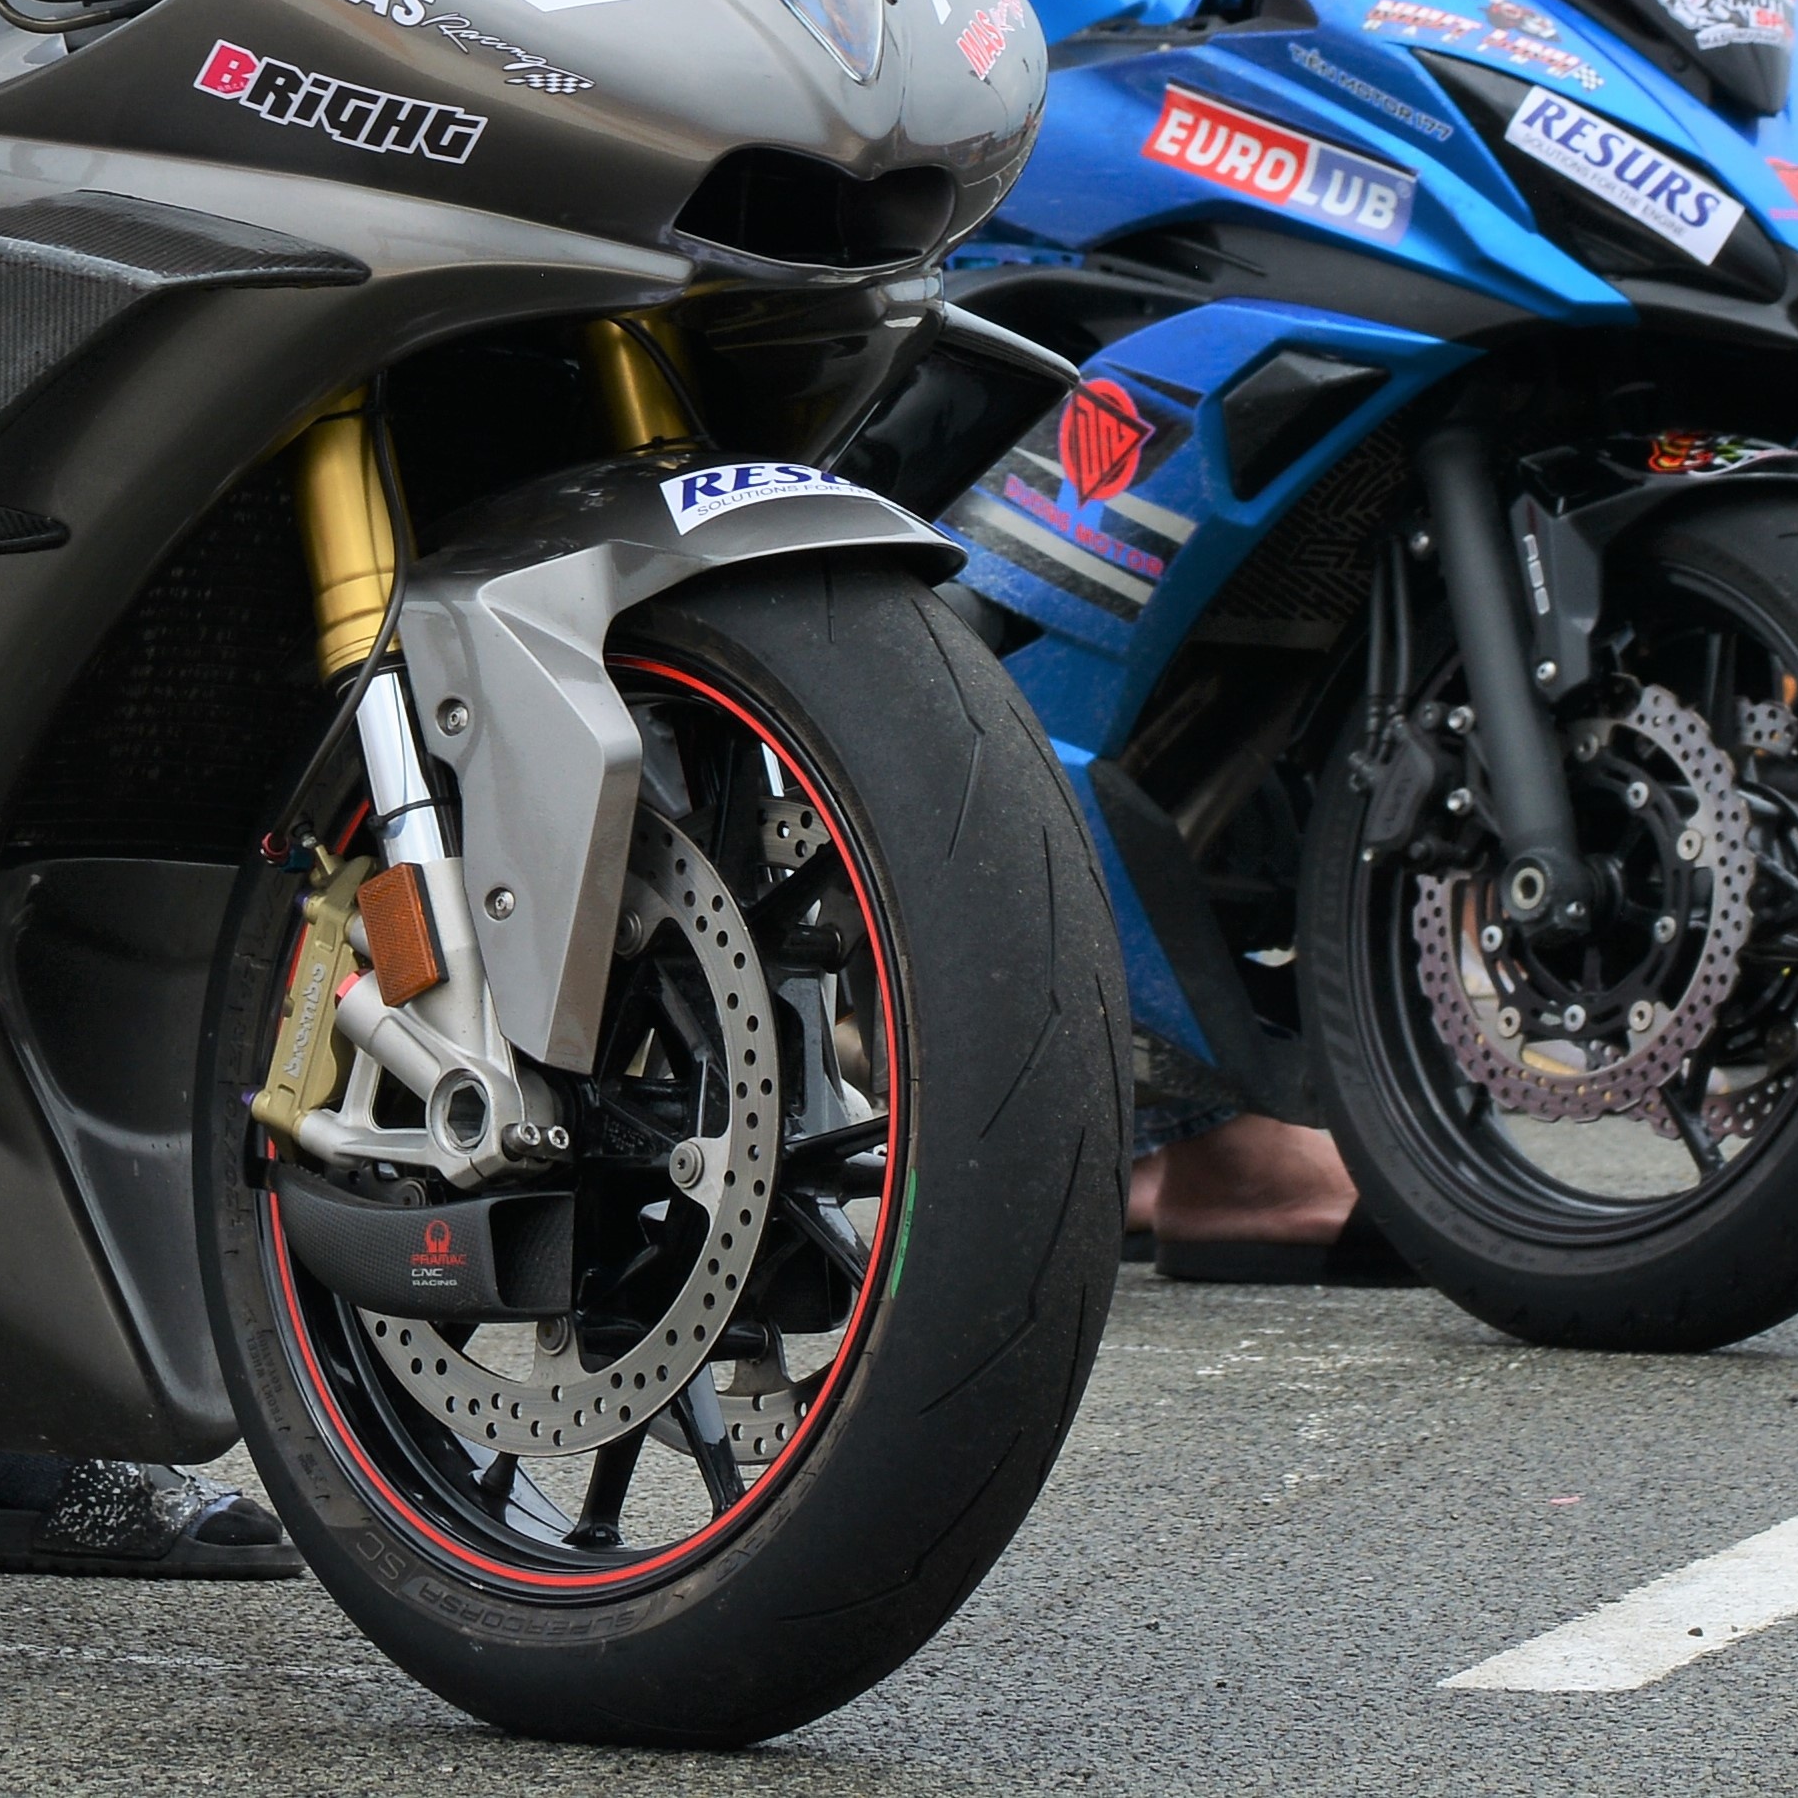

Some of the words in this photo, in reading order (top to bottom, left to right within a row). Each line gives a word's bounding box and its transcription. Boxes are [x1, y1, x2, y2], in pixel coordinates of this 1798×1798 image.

[956, 9, 1006, 81] MAS
[1154, 108, 1399, 231] EUROLUB
[1521, 96, 1721, 231] RESURS
[697, 483, 799, 517] SOLUTIONS
[283, 962, 327, 1079] brembo
[411, 1268, 444, 1277] CNC
[412, 1279, 458, 1287] RACING
[417, 1581, 635, 1636] SUPERCORSA
